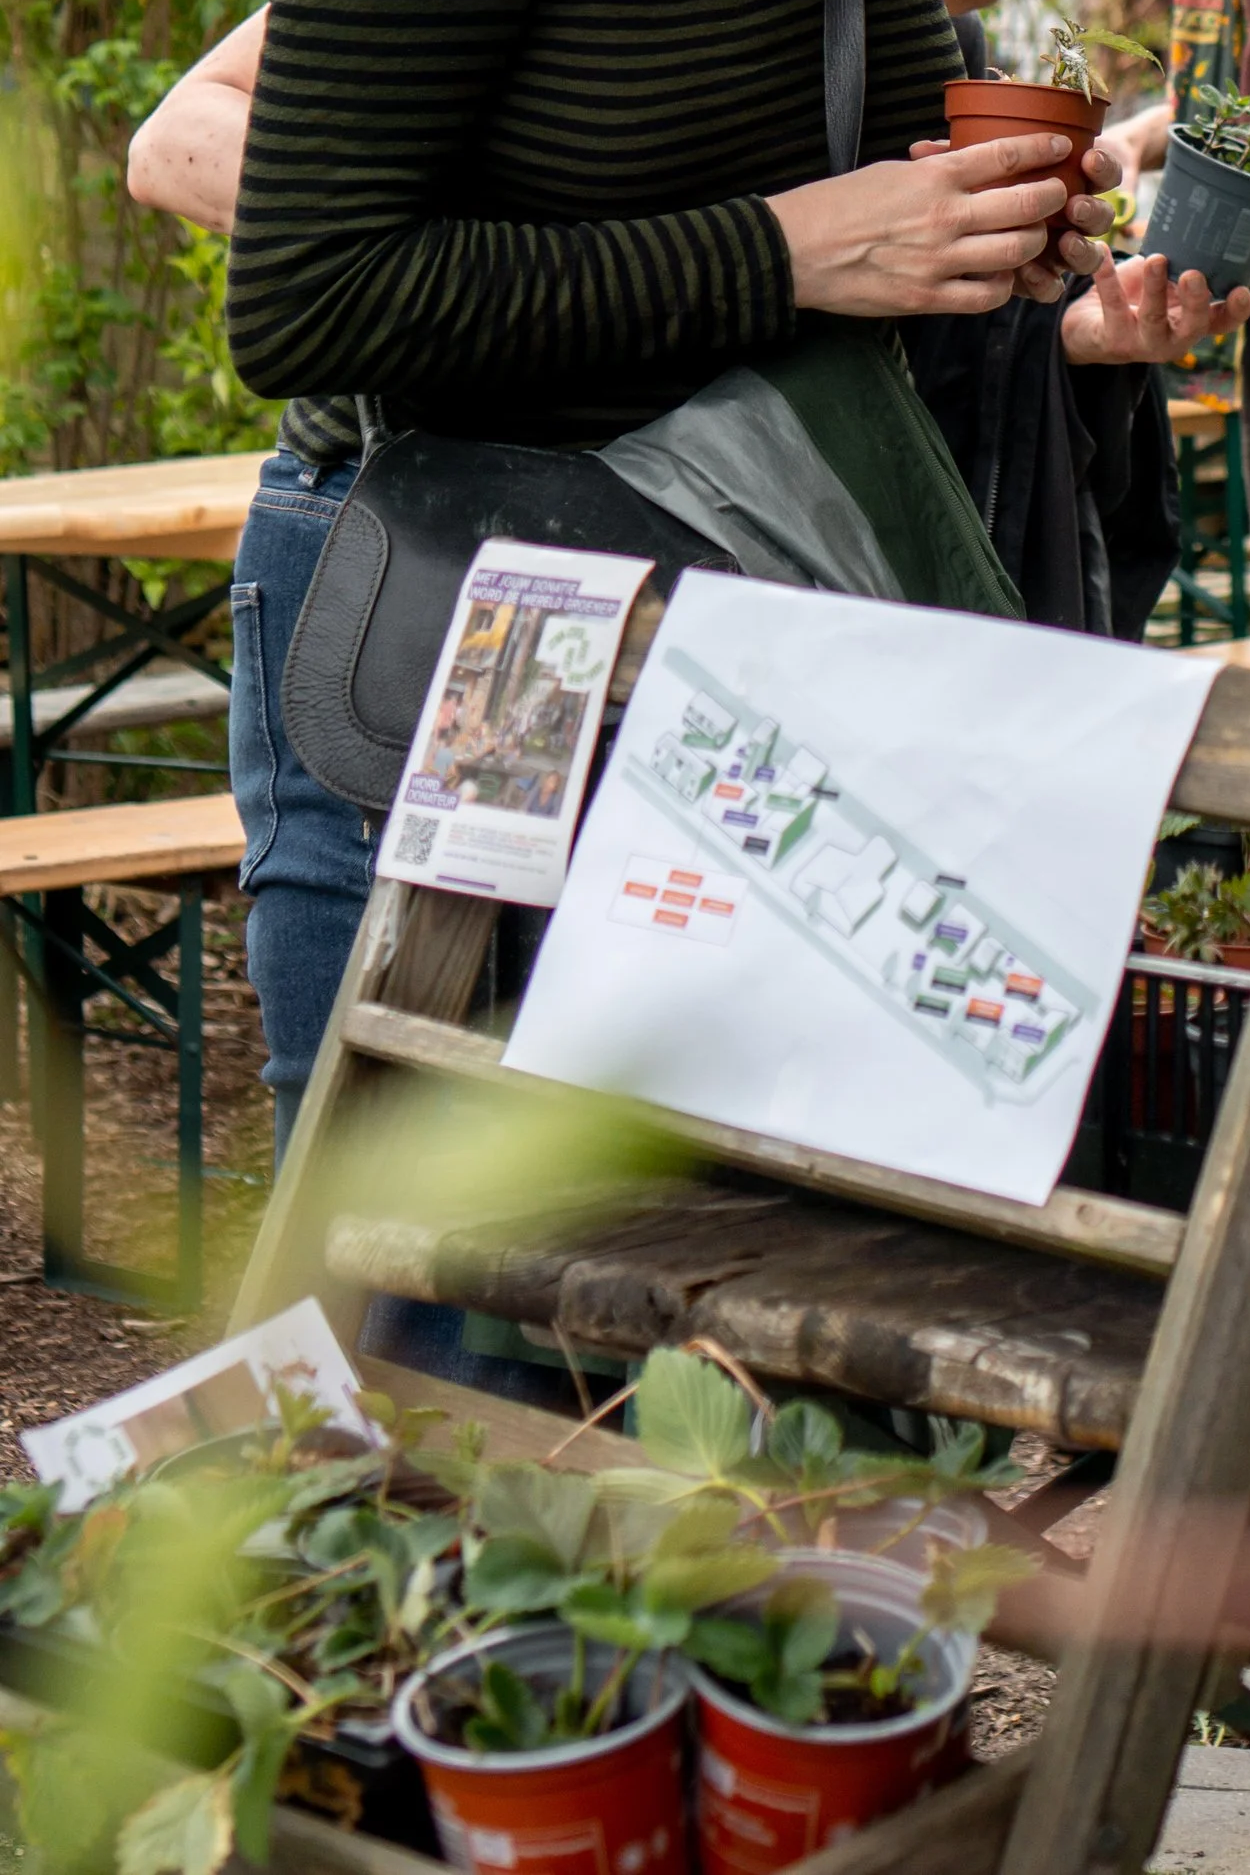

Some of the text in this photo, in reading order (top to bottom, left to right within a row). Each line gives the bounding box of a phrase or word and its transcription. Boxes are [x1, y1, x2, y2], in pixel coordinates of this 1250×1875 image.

[474, 571, 578, 596] MET JOUW DONATIE
[470, 586, 618, 616] WORD DE WERELD GROENER!
[411, 775, 442, 792] WORD
[406, 789, 457, 809] DONATEUR
